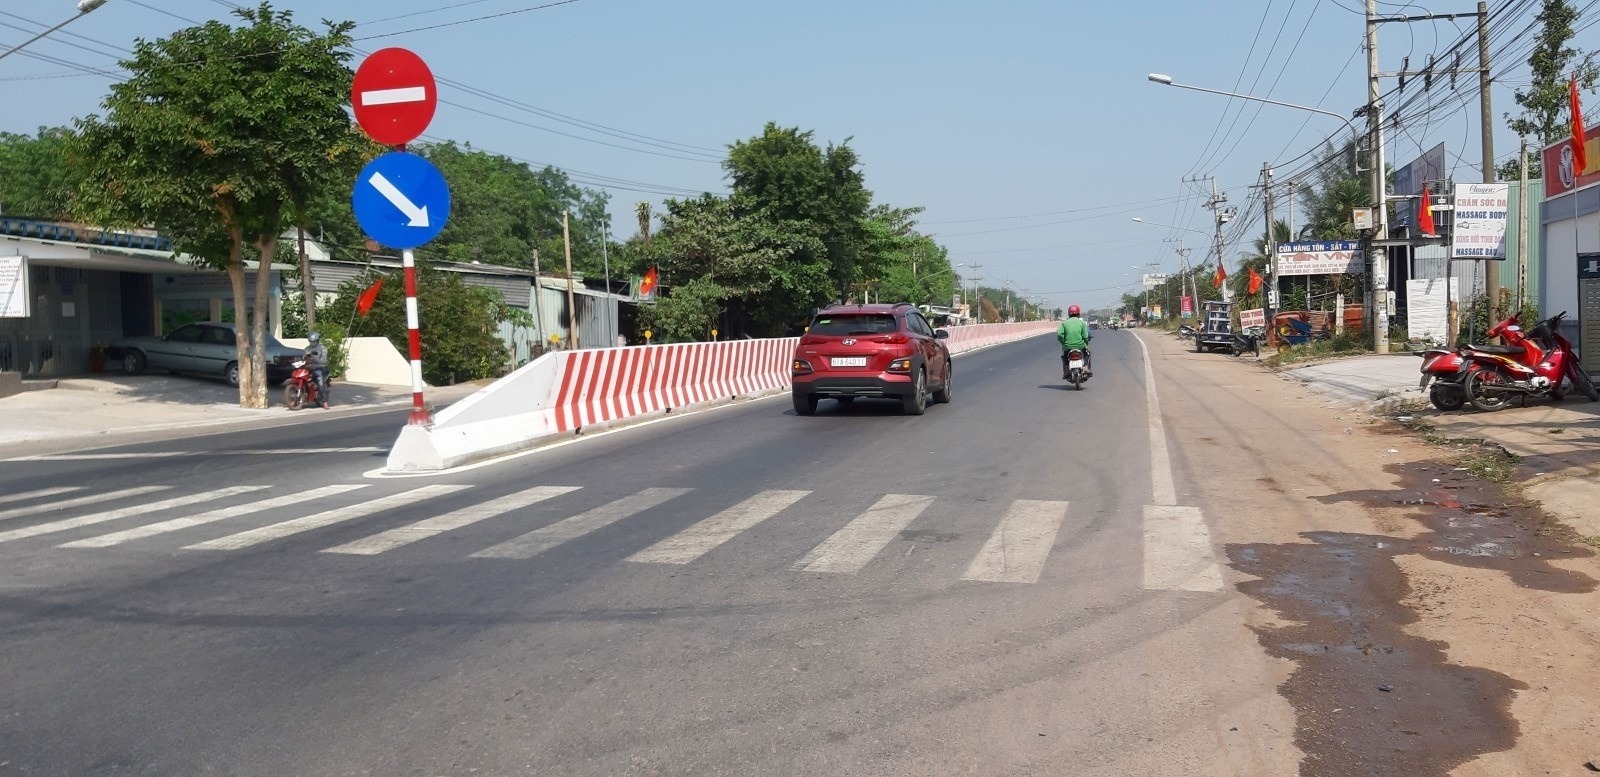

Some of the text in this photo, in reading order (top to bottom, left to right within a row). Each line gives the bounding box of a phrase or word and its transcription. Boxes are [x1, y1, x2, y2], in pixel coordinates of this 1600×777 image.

[1456, 198, 1478, 206] CHĂM
[1480, 197, 1494, 207] SÓC
[1497, 199, 1507, 207] DA
[1489, 211, 1507, 219] BODY
[1278, 244, 1292, 252] CỬA
[1312, 242, 1325, 251] TÔN
